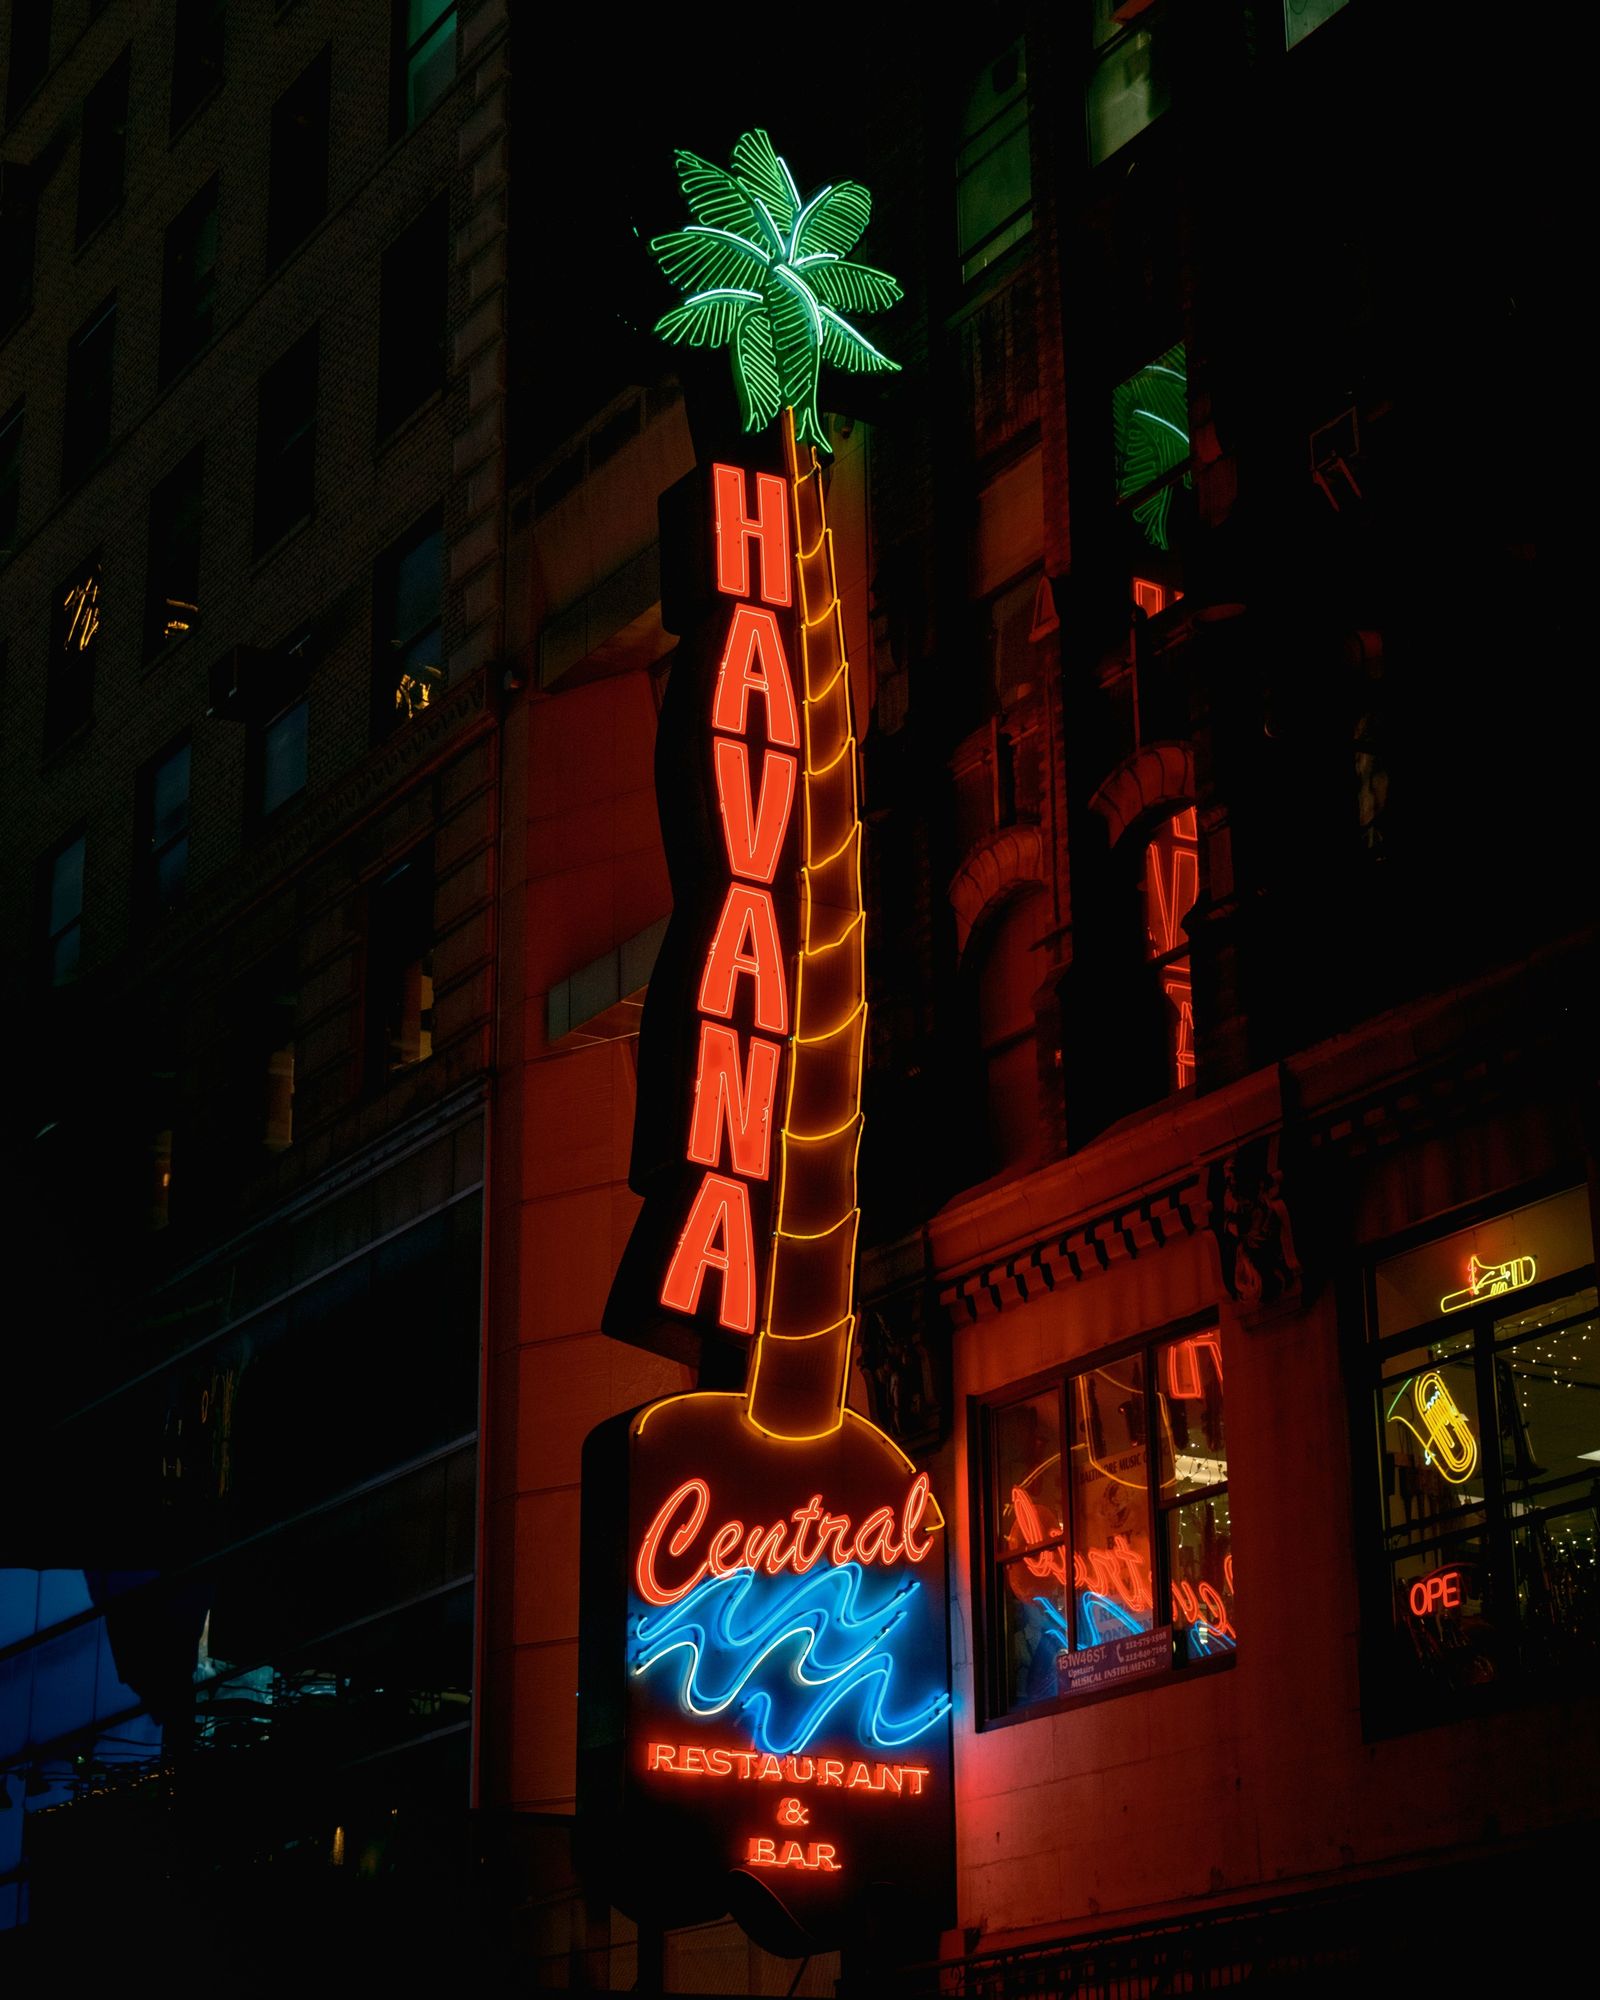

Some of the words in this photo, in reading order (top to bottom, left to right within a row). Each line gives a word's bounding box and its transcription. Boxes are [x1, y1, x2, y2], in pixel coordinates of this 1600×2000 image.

[660, 463, 801, 1335] HAVANA
[636, 1472, 933, 1606] Central
[1410, 1572, 1460, 1616] OPE
[1071, 1671, 1103, 1689] MUSICAL
[1103, 1658, 1158, 1680] INSTRUMENTS
[647, 1741, 930, 1796] RESTAURANT
[776, 1797, 810, 1827] &
[747, 1837, 843, 1871] BAR
